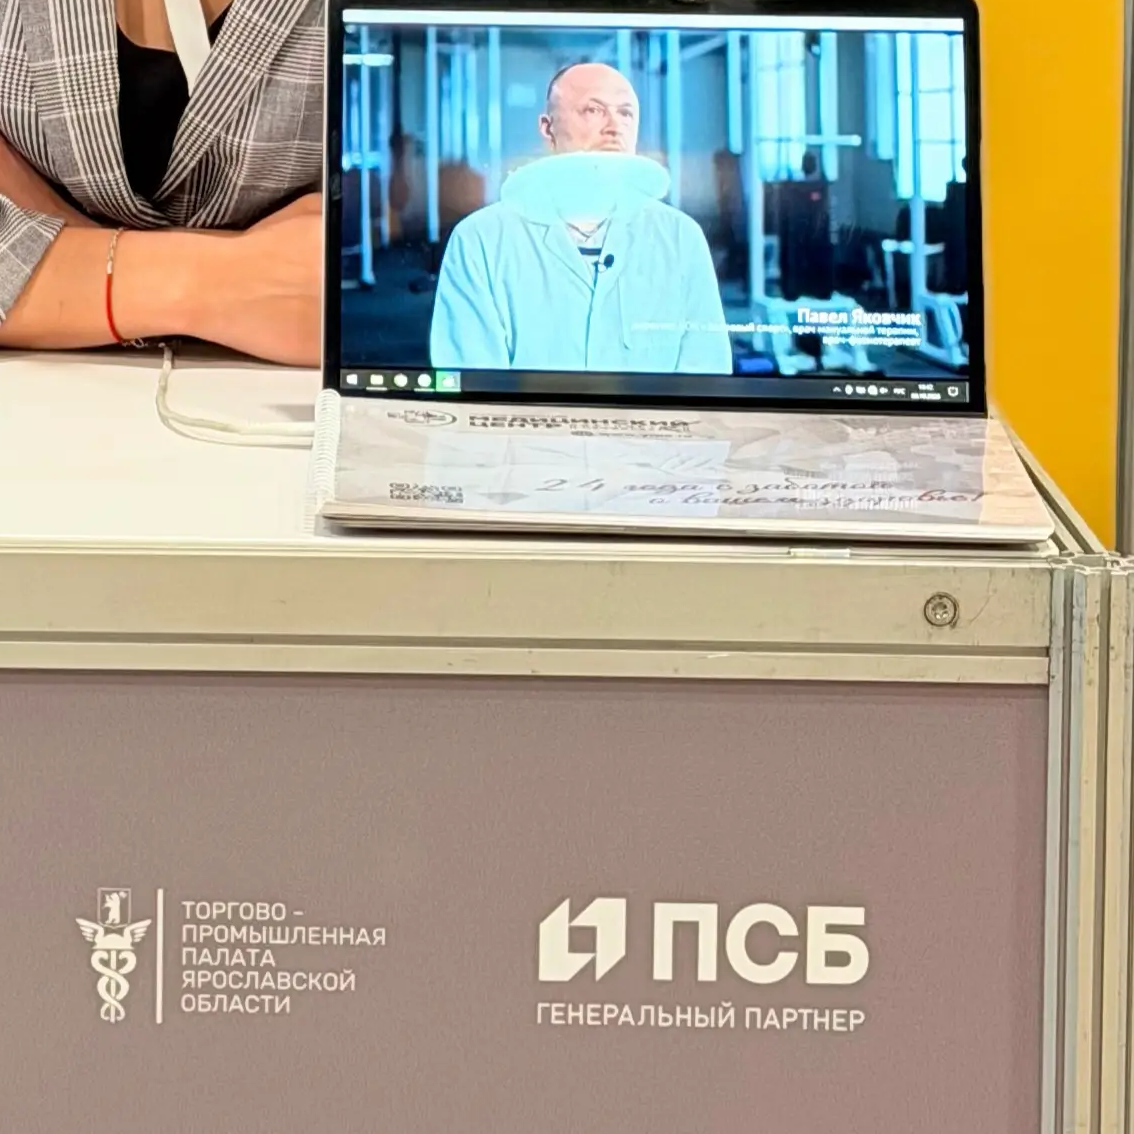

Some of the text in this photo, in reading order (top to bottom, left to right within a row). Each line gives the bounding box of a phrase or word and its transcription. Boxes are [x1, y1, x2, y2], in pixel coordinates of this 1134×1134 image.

[797, 308, 921, 326] Павел Яковчик
[181, 901, 286, 921] ТОРГОВО
[181, 924, 386, 945] ПРОМЫШЛЕННАЯ
[653, 902, 869, 985] ПСБ
[181, 947, 275, 967] ПАЛАТА
[181, 969, 356, 991] ЯРОСЛАВСКОЙ
[181, 994, 291, 1014] ОБЛАСТИ
[536, 1002, 865, 1031] ГЕНЕРАЛЬНЫЙ ПАРТНЕР
